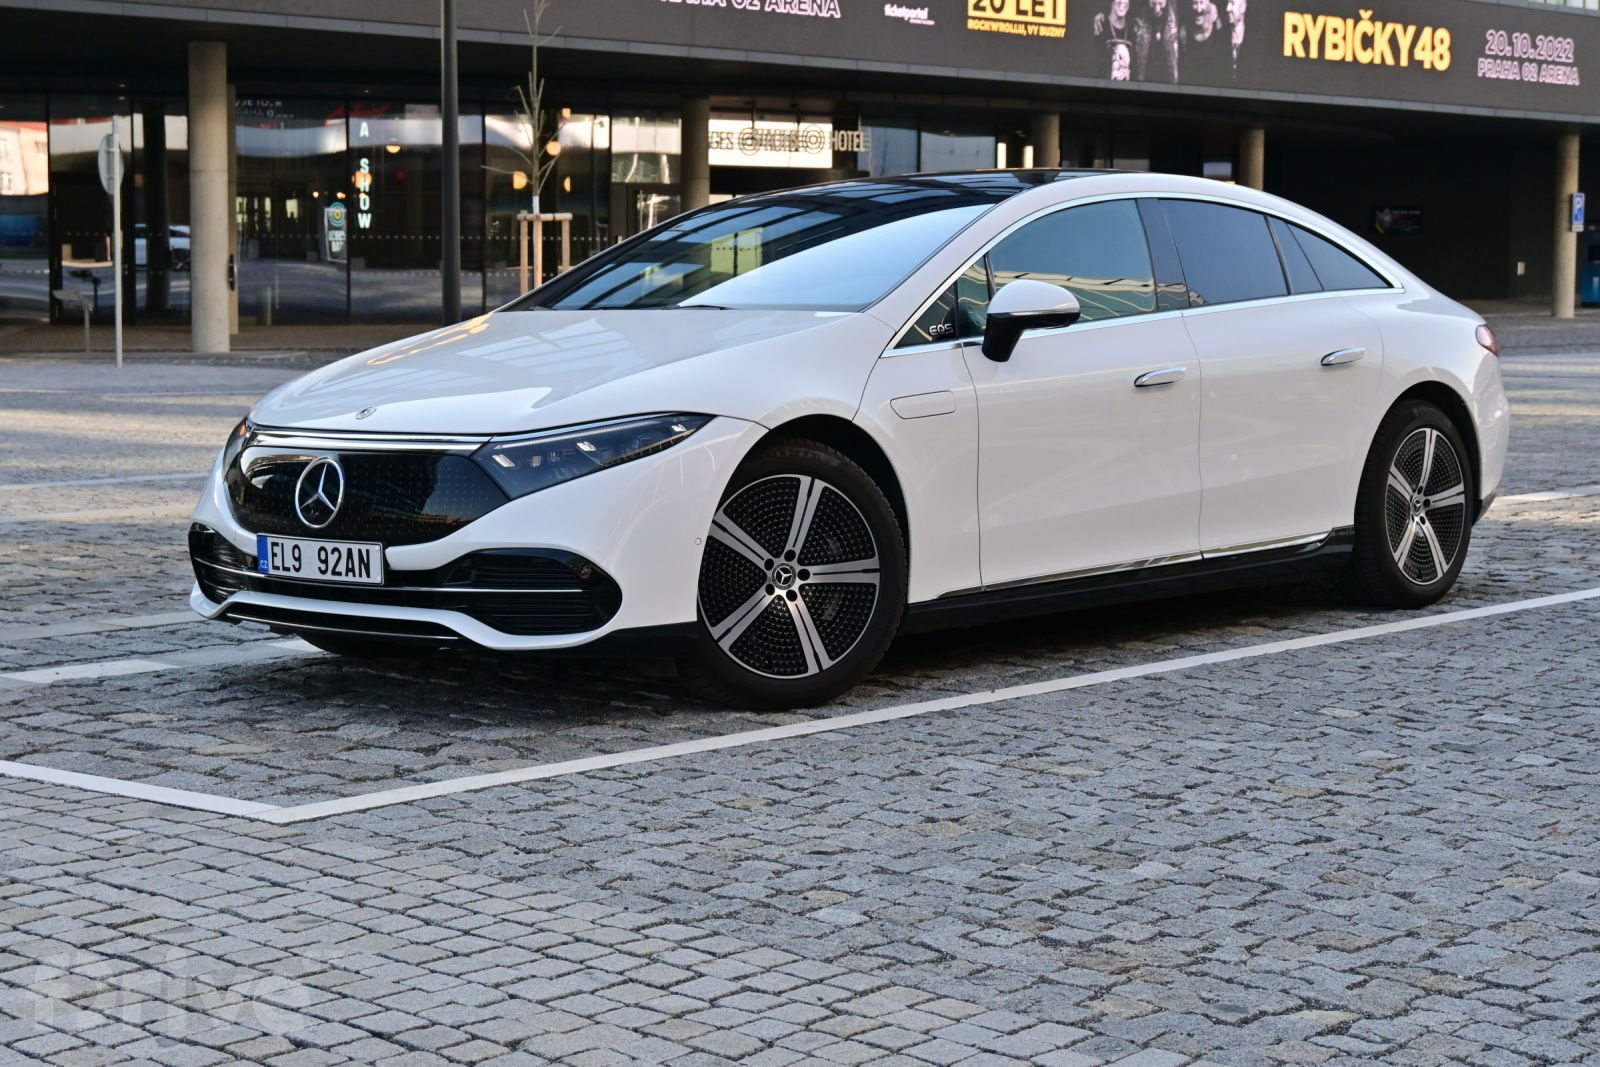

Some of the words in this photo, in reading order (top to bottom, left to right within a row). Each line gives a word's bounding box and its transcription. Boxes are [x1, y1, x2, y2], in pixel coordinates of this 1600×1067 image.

[1283, 9, 1451, 71] RYBIČKY48
[1485, 29, 1575, 63] 20.10.2022
[1477, 57, 1521, 80] PRAHA
[1538, 63, 1580, 86] ARENA
[359, 122, 369, 138] A
[831, 130, 865, 151] HOTEL
[929, 323, 954, 337] EQS
[271, 541, 302, 573] EL9
[317, 546, 371, 579] 92AN
